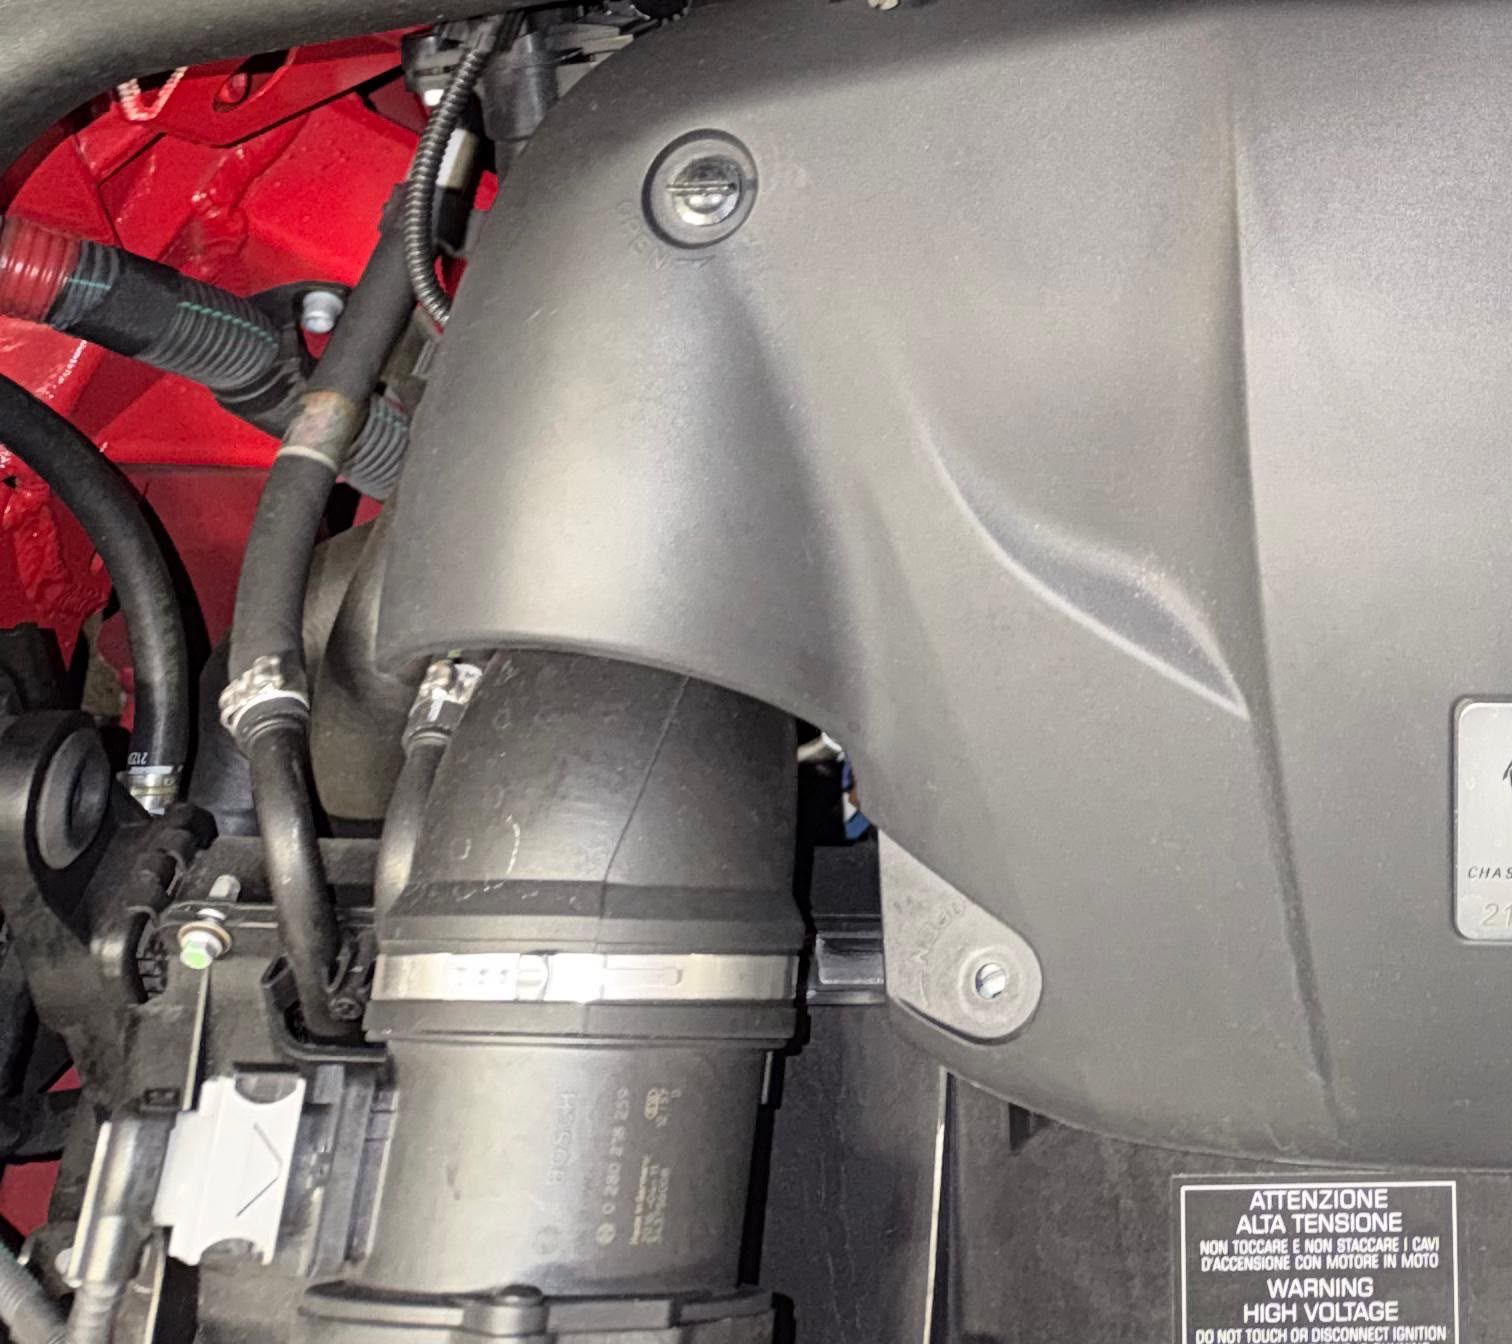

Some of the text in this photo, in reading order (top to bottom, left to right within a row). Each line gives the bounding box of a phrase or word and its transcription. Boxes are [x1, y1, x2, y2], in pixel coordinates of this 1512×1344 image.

[1249, 1188, 1389, 1211] ATTENZIONE
[1235, 1212, 1402, 1235] ALTA TENSIONE
[1199, 1239, 1228, 1255] NON
[1232, 1239, 1288, 1255] TOCCARE
[1292, 1238, 1301, 1254] E
[1304, 1238, 1332, 1254] NON
[1337, 1237, 1399, 1253] STACCARE
[1412, 1236, 1440, 1252] CAVI
[1201, 1252, 1439, 1272] D'ACCENSIONE CON MOTORE IN MOTO
[1267, 1277, 1374, 1299] WARNING
[1243, 1301, 1399, 1324] HIGH VOLTAGE
[1195, 1326, 1447, 1344] DO NOT TOUCH OR DISCONNECT IGNITION
